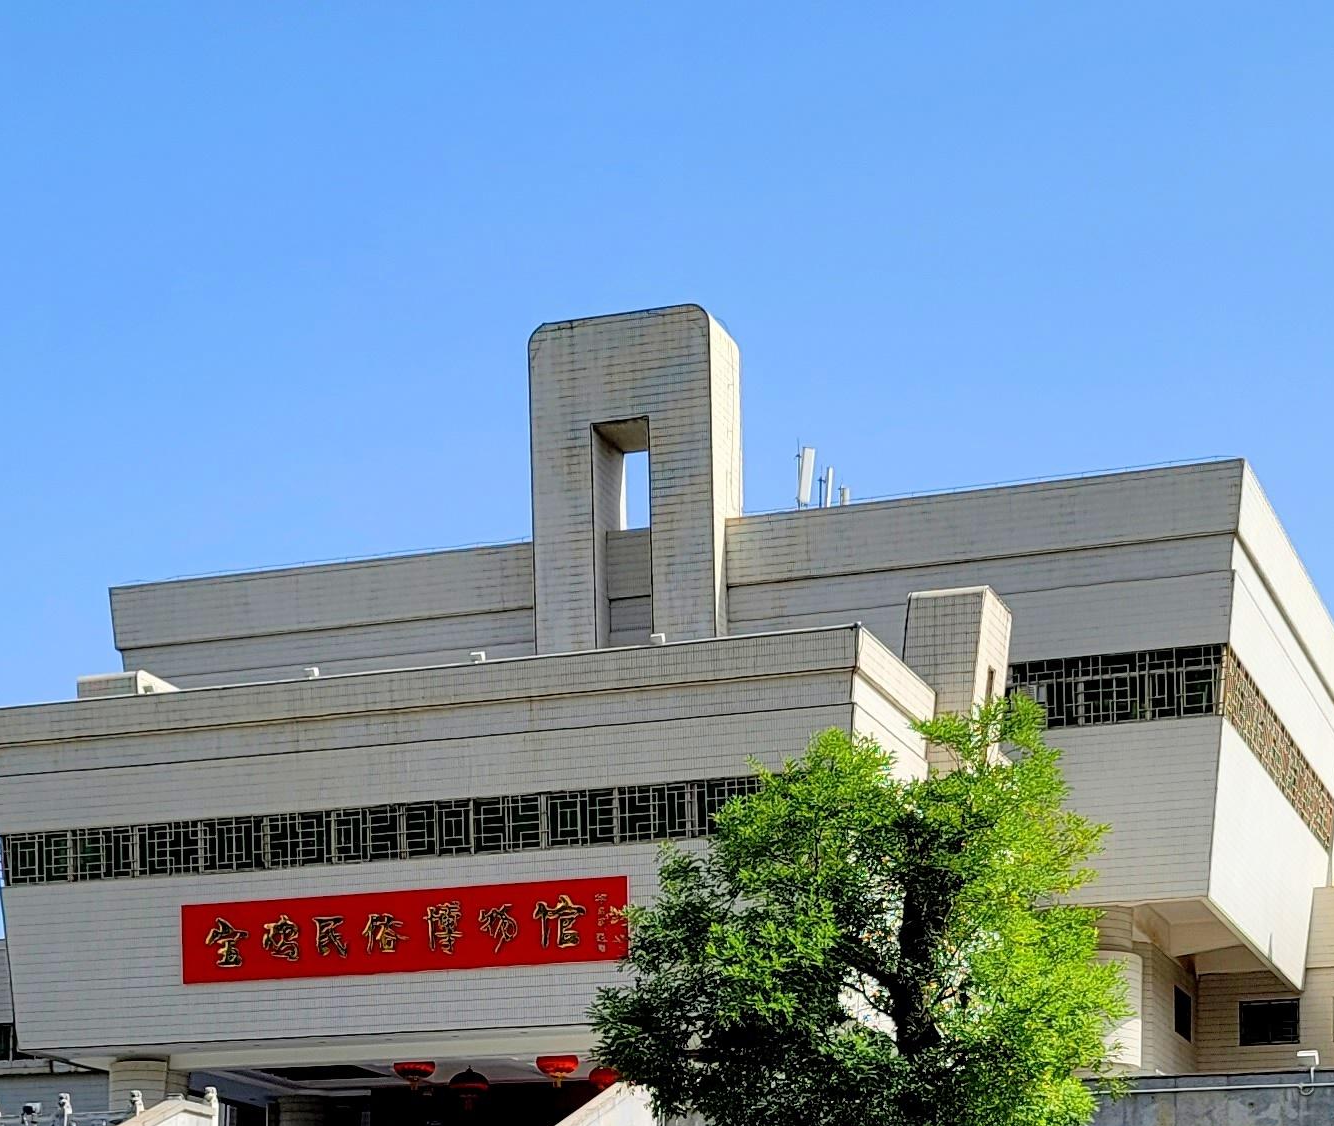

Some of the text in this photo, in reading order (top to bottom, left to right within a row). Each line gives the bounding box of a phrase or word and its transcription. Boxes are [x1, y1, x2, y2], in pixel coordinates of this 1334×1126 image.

[205, 894, 587, 968] 宝鸡民俗博物馆
